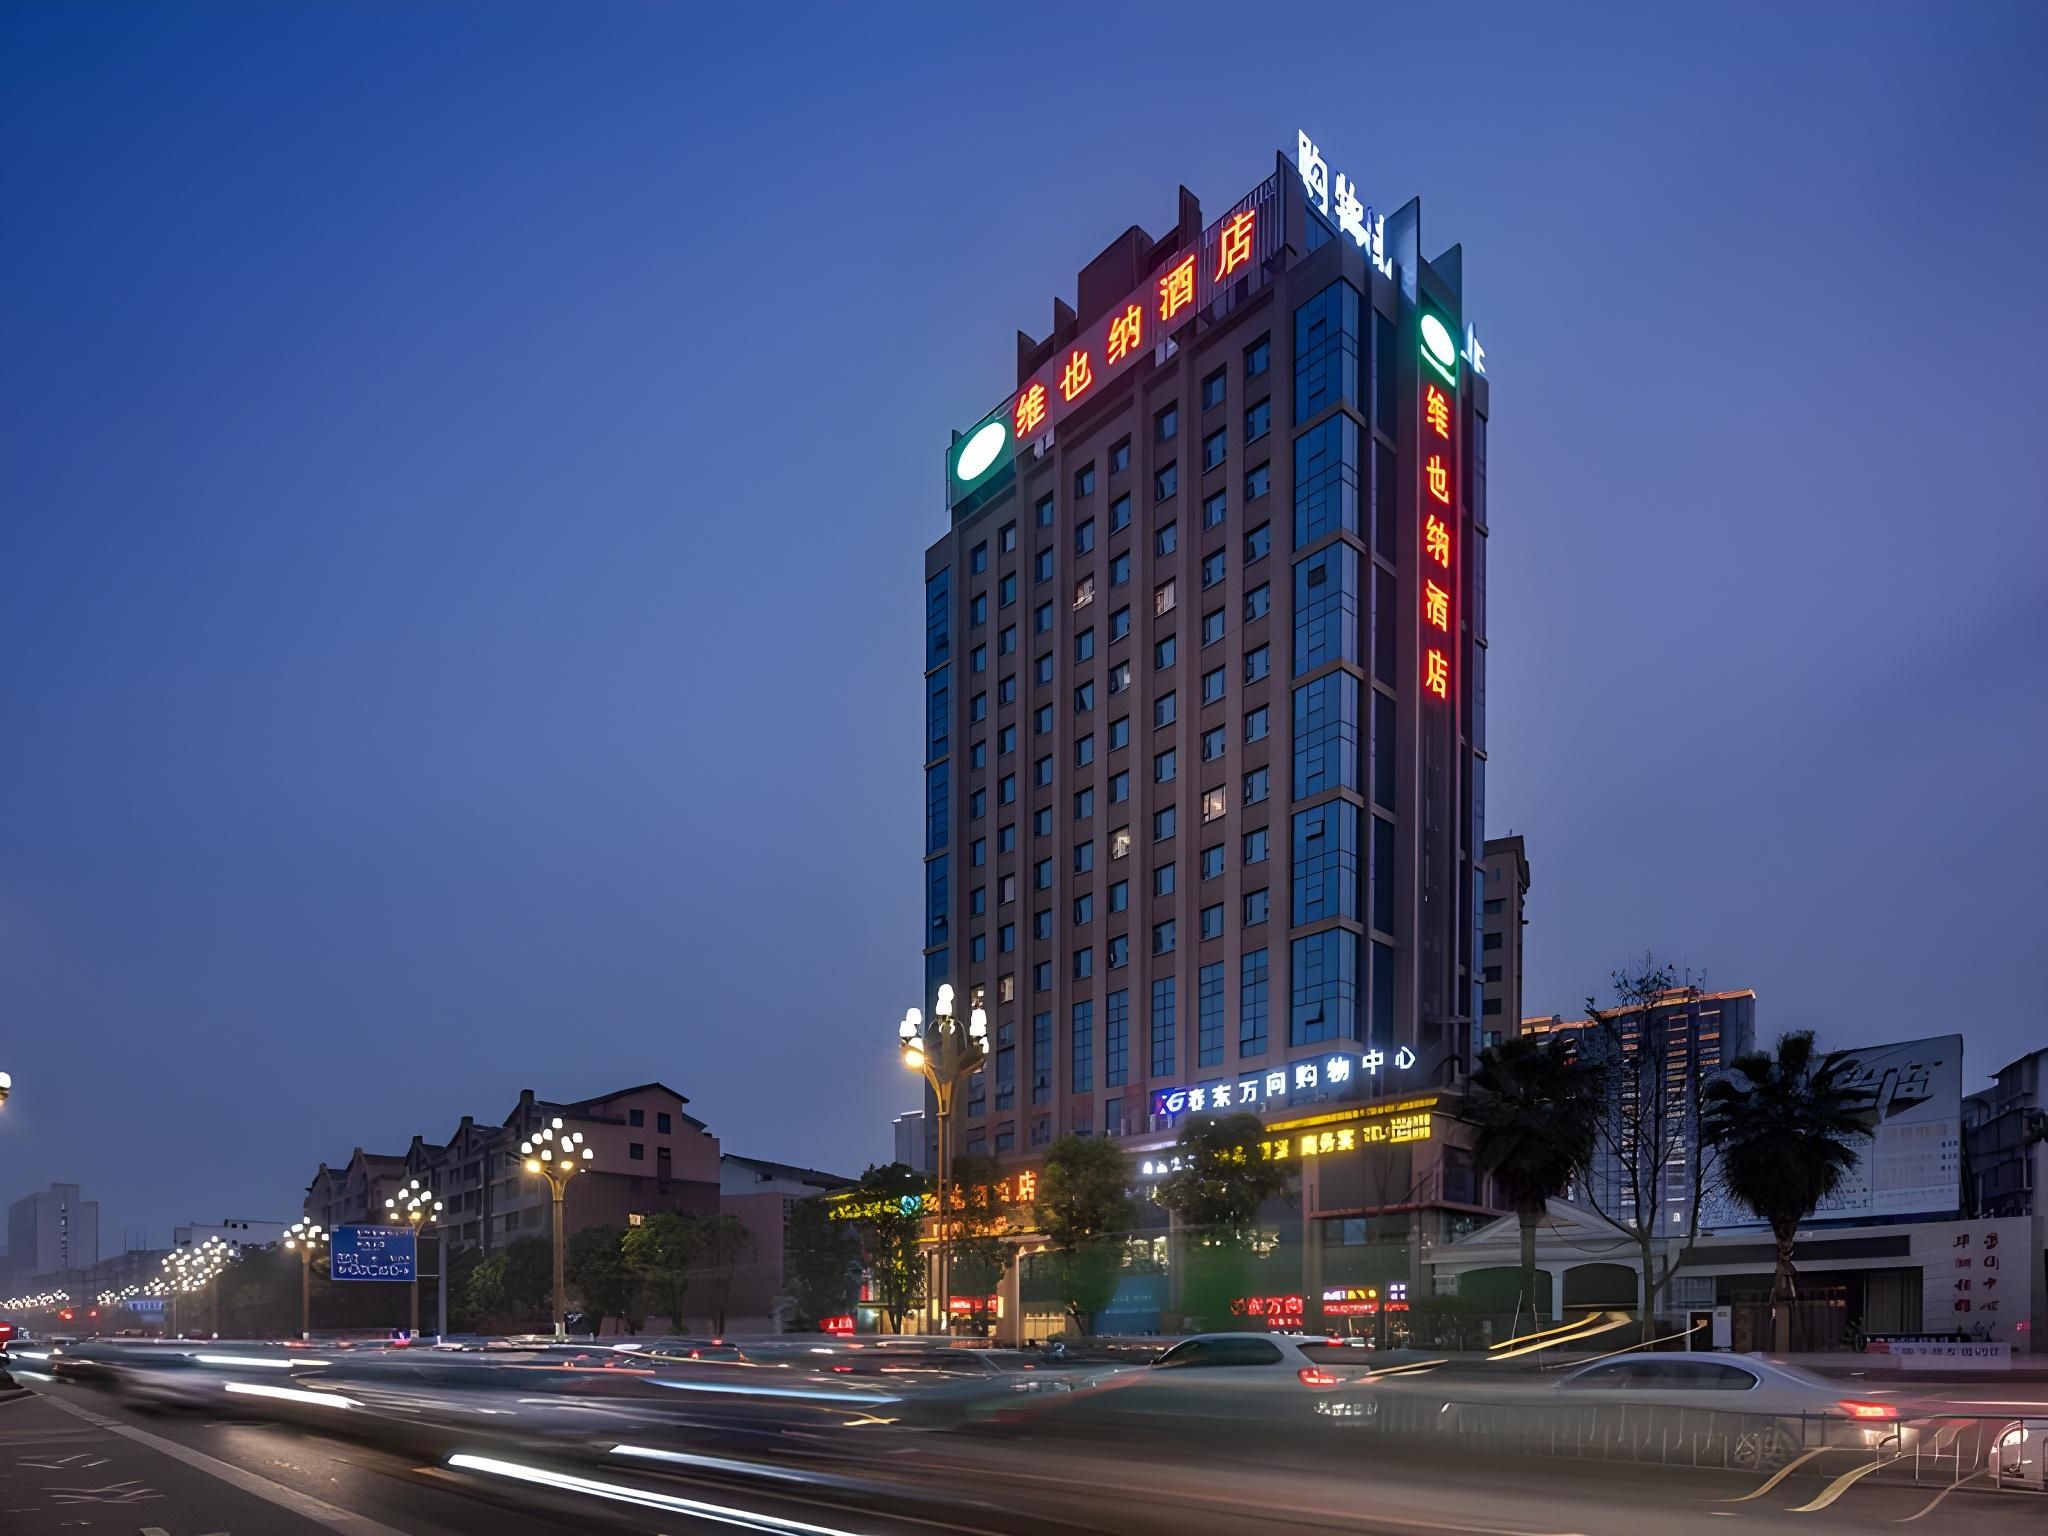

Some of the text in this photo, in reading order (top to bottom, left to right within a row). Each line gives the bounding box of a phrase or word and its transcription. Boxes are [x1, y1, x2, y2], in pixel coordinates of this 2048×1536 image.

[1015, 209, 1256, 438] 维也纳酒店
[1426, 385, 1449, 699] 维也纳酒店
